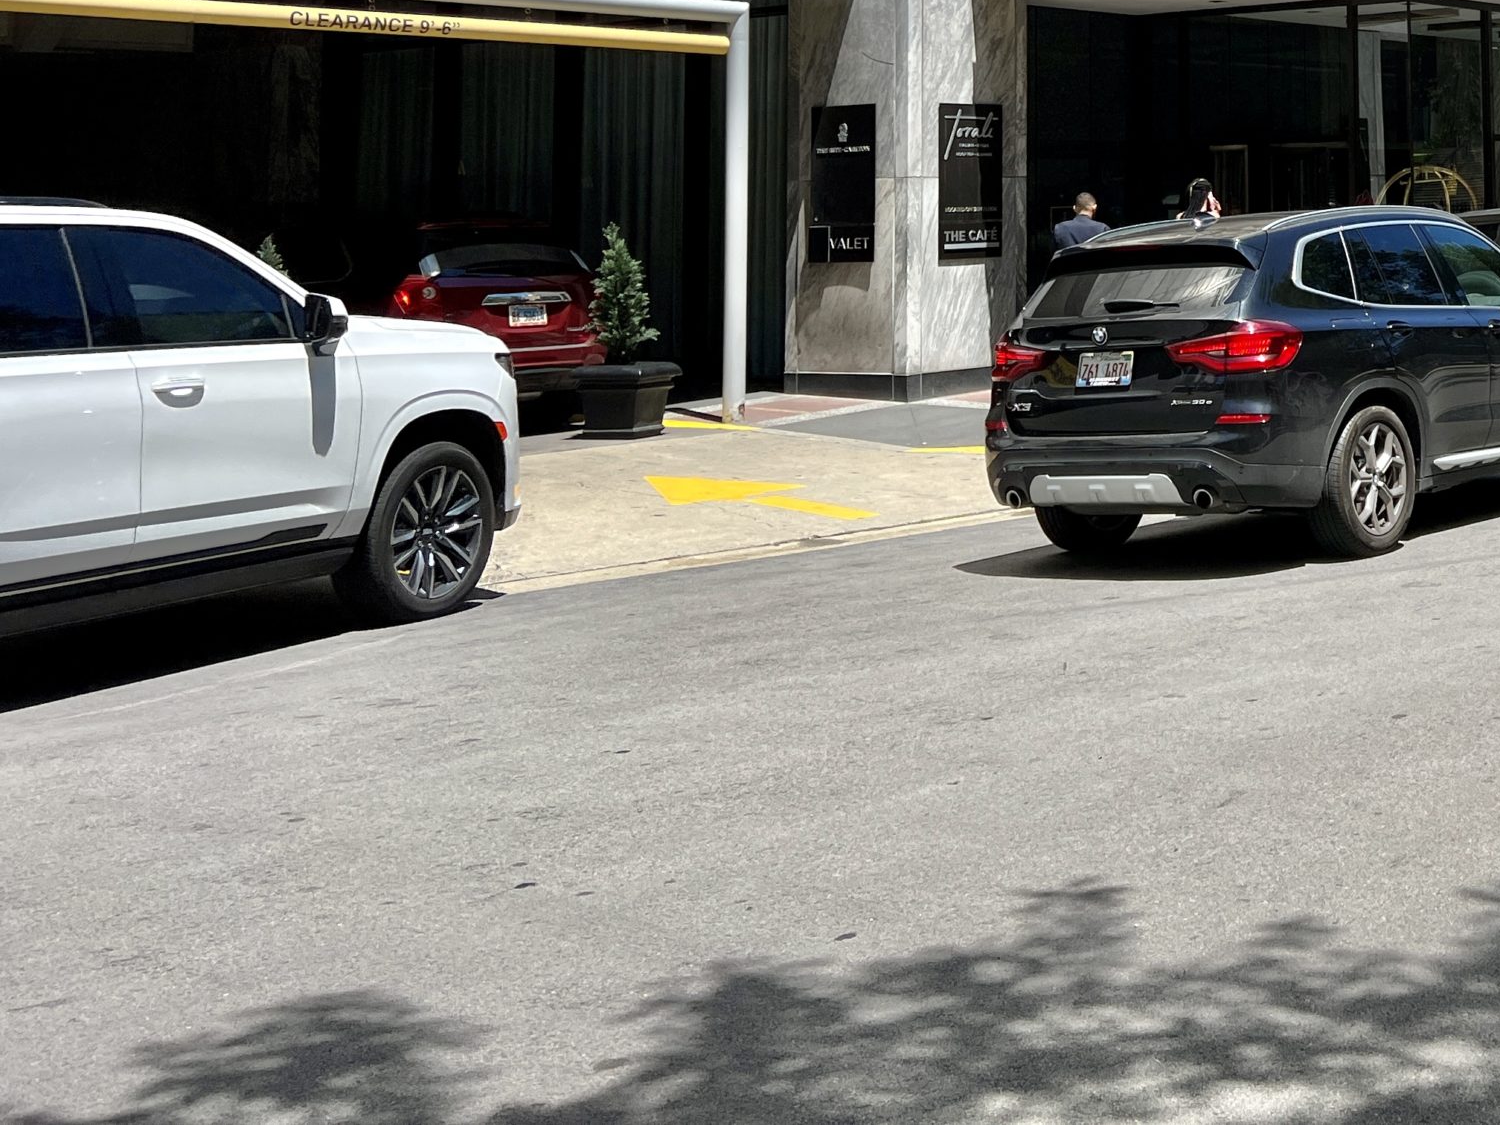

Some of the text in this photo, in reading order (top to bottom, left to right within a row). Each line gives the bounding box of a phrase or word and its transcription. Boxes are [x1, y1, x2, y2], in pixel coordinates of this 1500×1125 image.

[289, 11, 414, 33] CLEARANCE
[944, 226, 998, 242] THE CAFÉ
[830, 237, 870, 250] VALET
[1011, 402, 1032, 412] X3
